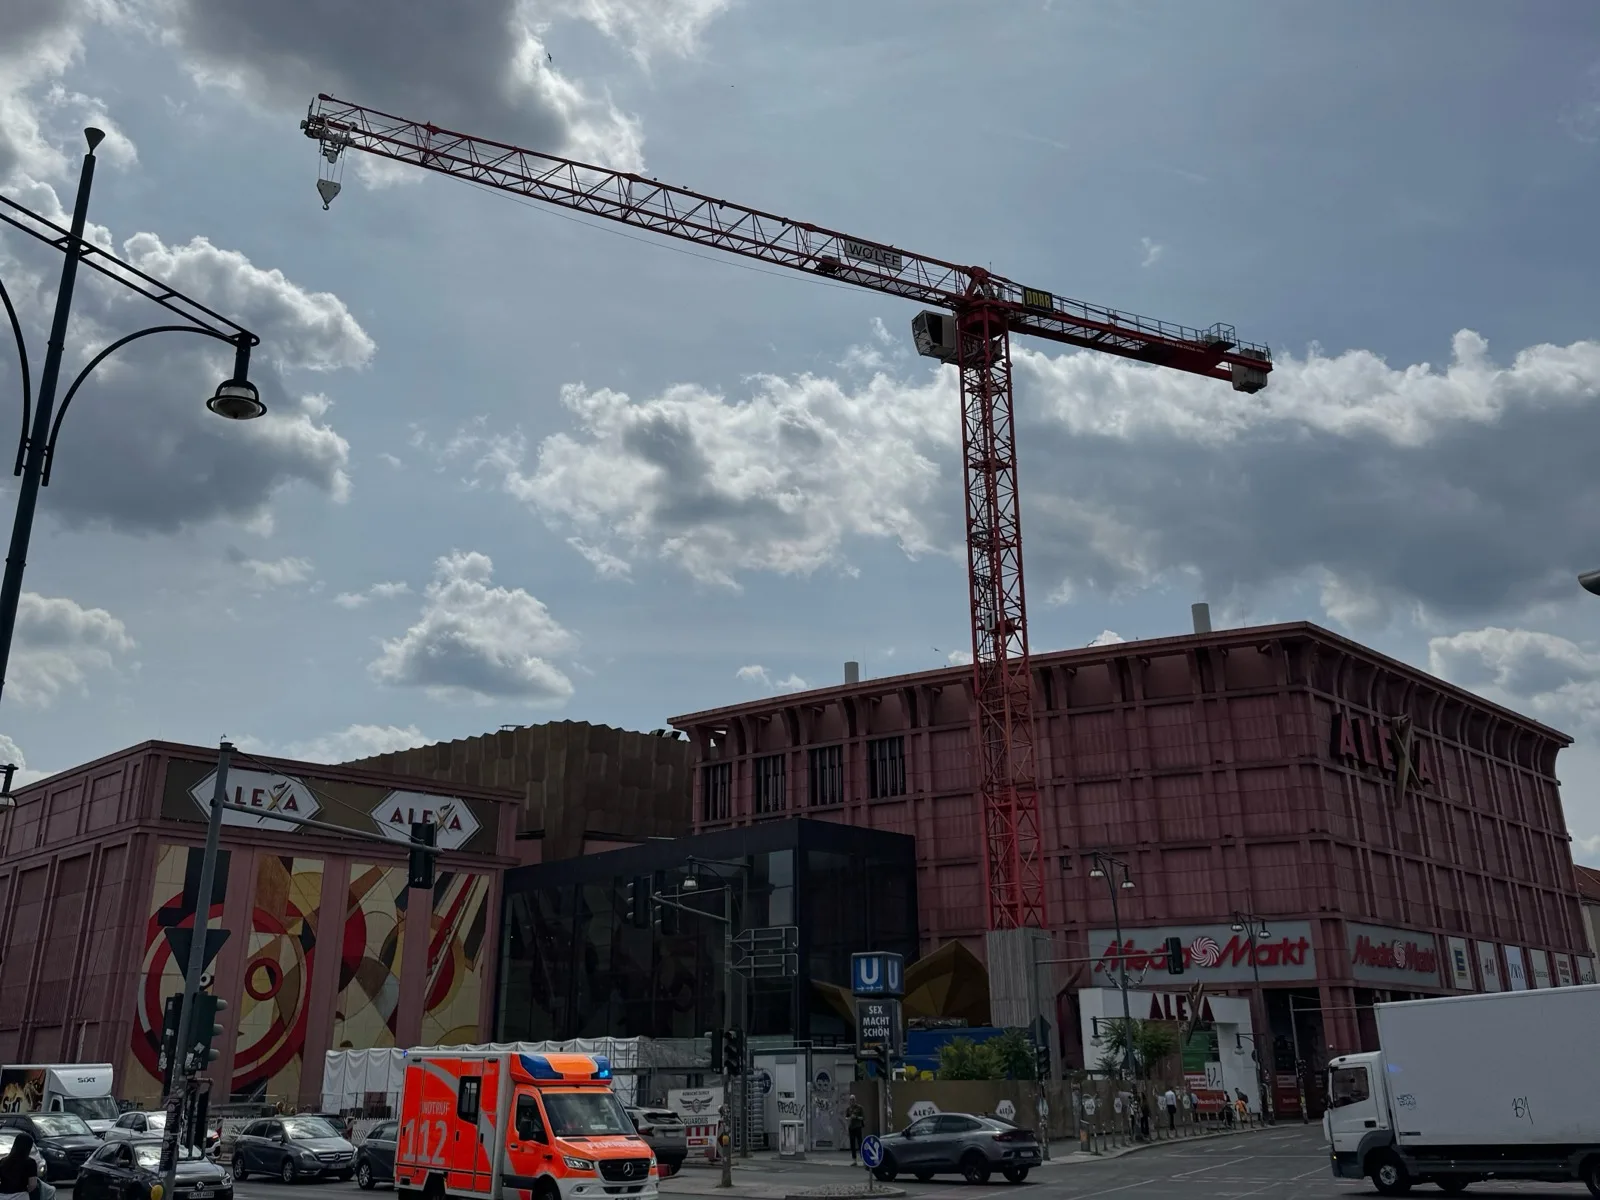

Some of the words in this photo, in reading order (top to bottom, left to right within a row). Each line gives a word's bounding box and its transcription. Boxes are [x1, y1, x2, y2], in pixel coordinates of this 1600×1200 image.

[849, 243, 900, 265] WOLFF
[1332, 714, 1436, 804] ALEXA
[390, 803, 462, 834] ALEXA
[1094, 939, 1191, 972] Meda
[860, 957, 879, 985] U
[888, 960, 898, 989] U
[863, 1017, 889, 1026] MACHT
[868, 1005, 883, 1014] SEX
[1150, 981, 1214, 1032] ALEXA
[863, 1025, 890, 1037] SCHÖN
[422, 1101, 451, 1115] NOTRUF
[403, 1118, 447, 1164] 112
